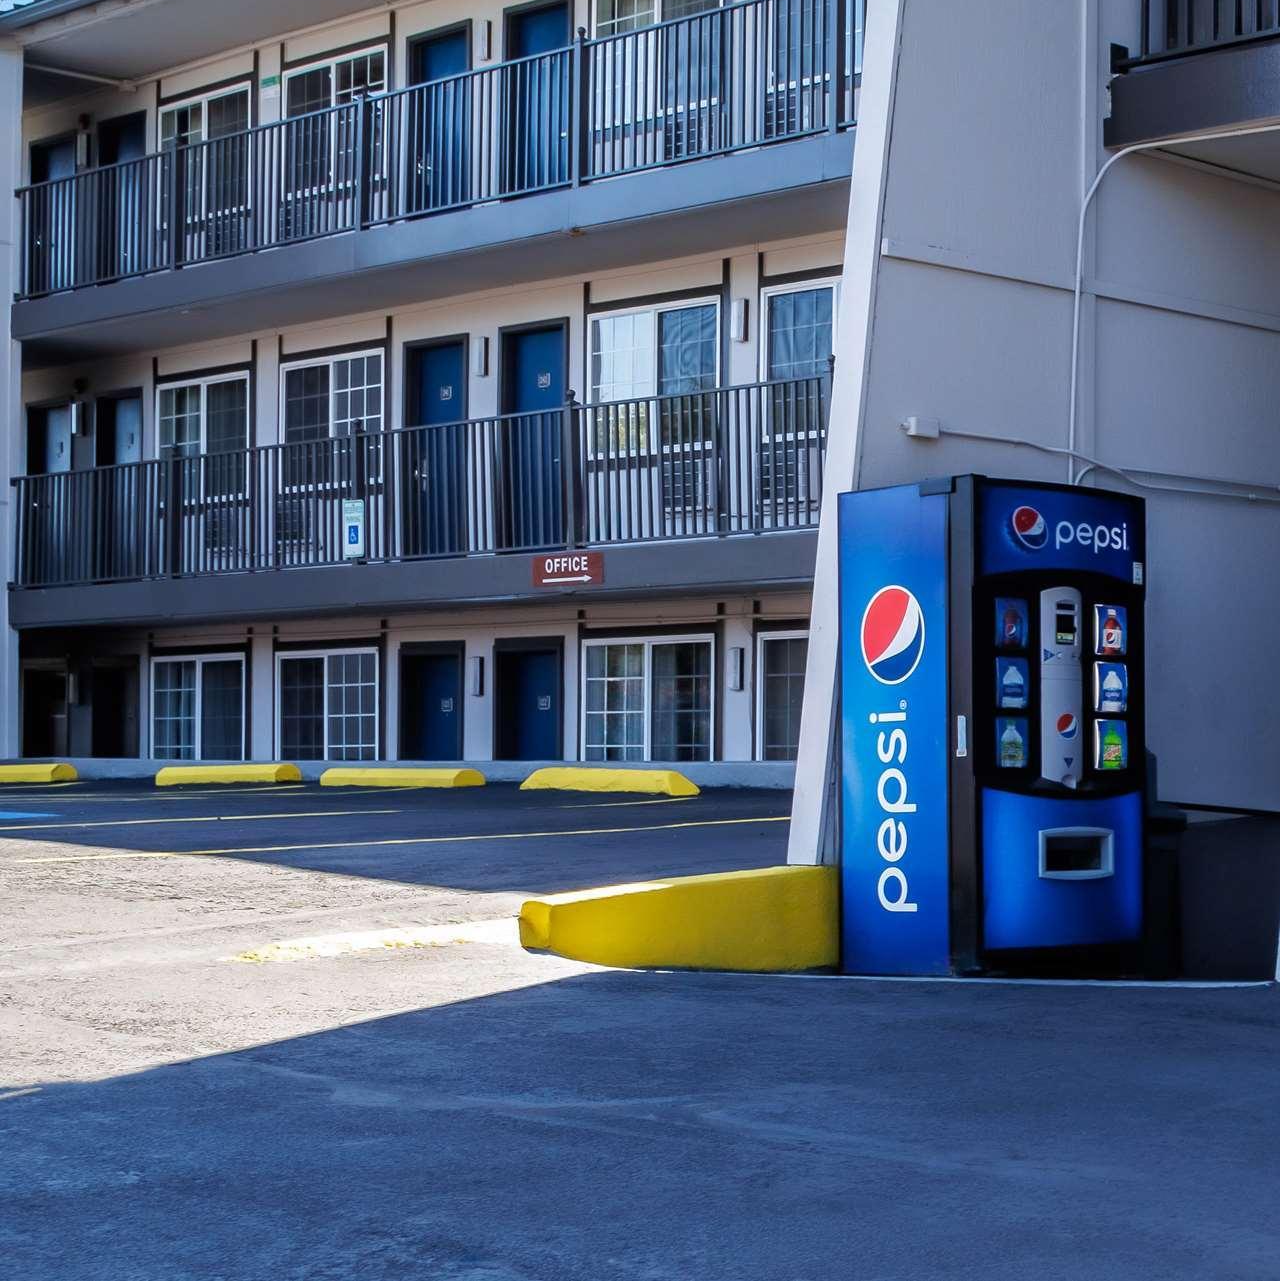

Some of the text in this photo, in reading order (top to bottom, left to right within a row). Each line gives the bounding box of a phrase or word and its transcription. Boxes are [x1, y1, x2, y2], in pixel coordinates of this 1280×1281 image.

[1056, 521, 1126, 553] pepsi
[545, 556, 588, 573] OFFICE
[869, 712, 917, 912] pepsi
